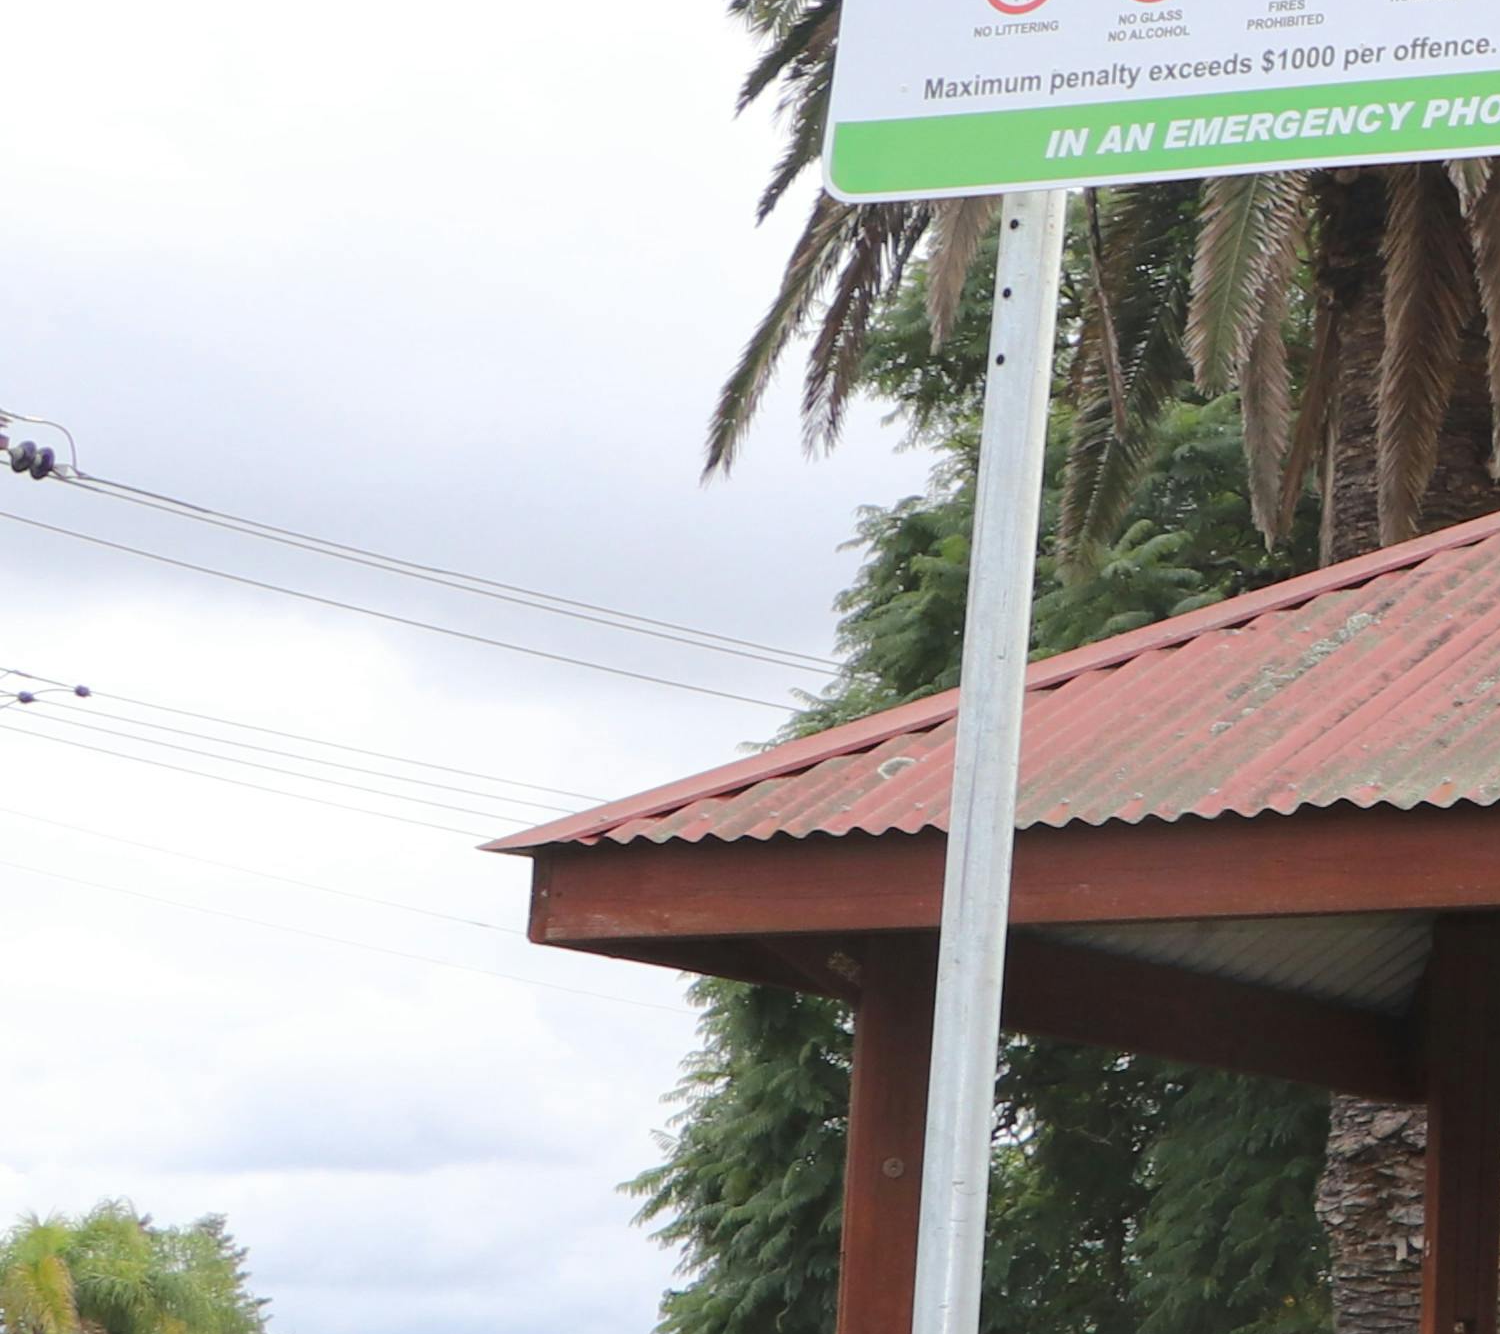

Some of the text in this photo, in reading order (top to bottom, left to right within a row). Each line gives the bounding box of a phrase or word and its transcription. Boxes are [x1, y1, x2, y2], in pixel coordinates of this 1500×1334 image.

[1117, 8, 1183, 25] NO GLASS
[1246, 12, 1325, 30] PROHIBITED
[973, 19, 1059, 38] NO LITTERING
[1107, 24, 1190, 42] NO ALCOHOL
[923, 36, 1496, 100] Maximum penalty exceeds $1000 per offence.
[1045, 127, 1090, 158] IN
[1095, 121, 1156, 154] AN
[1163, 100, 1415, 149] EMERGENCY
